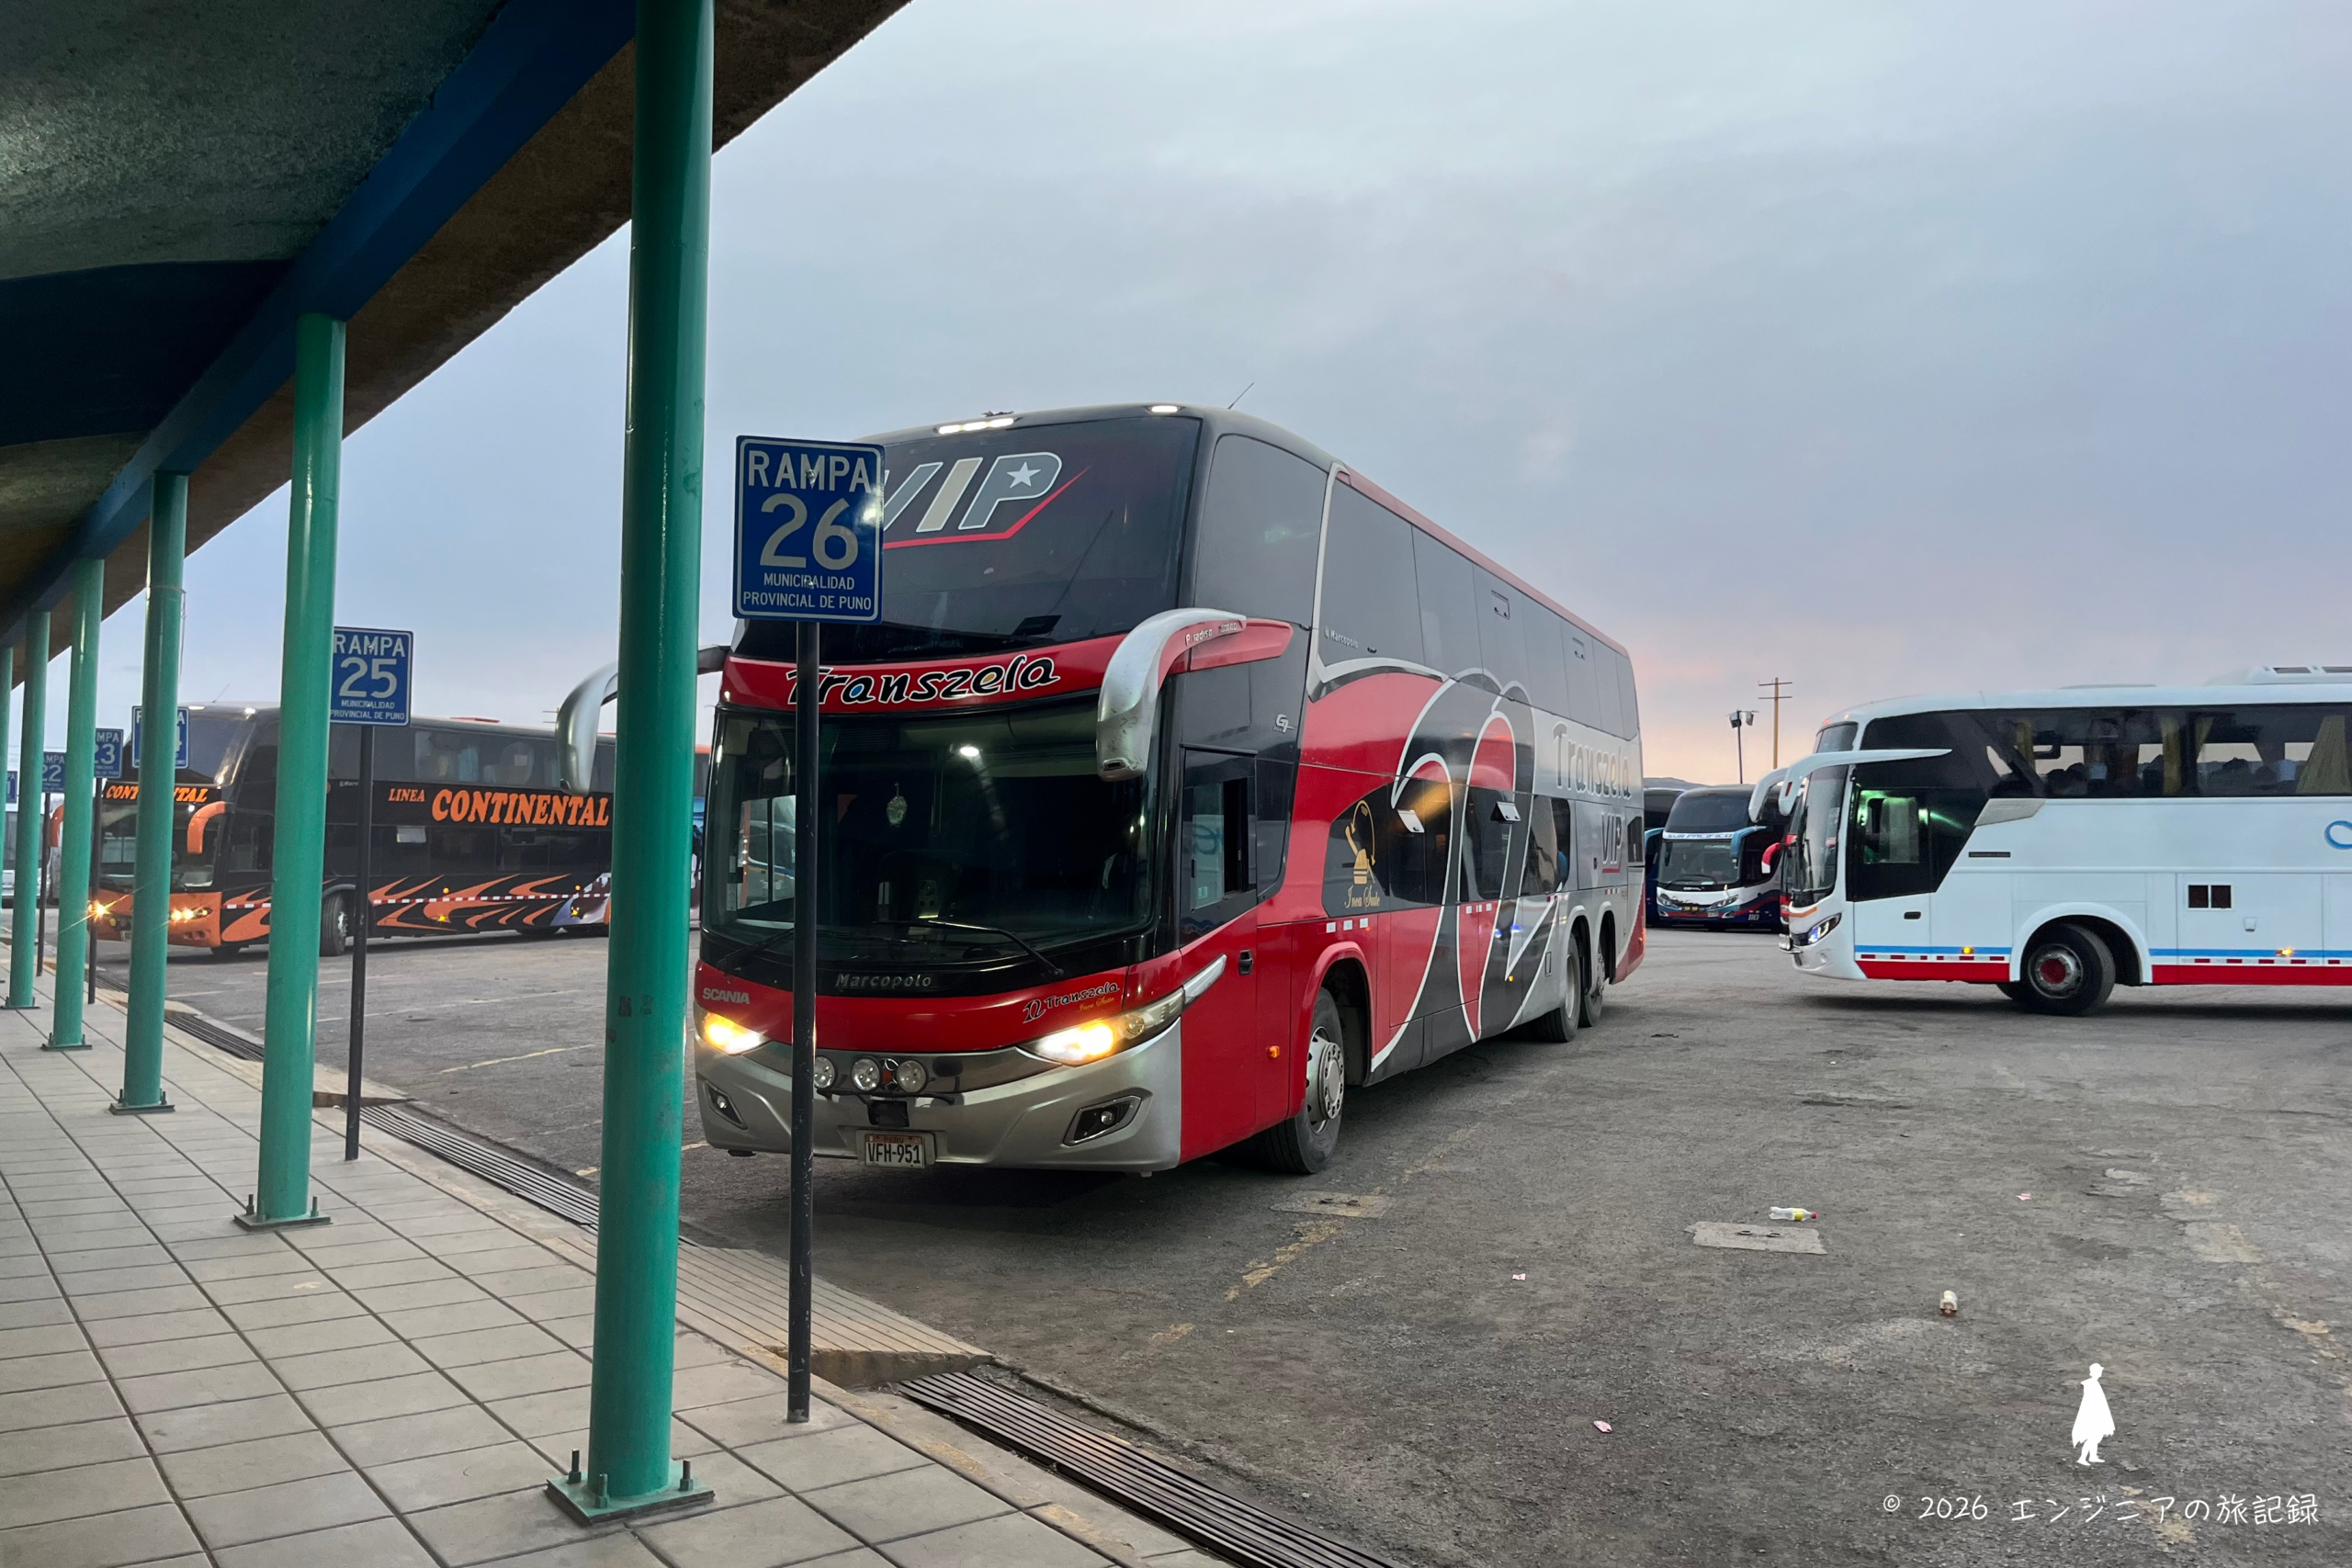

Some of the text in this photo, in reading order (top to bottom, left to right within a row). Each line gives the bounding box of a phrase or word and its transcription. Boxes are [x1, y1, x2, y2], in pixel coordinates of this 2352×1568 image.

[748, 450, 872, 494] RAMPA
[760, 492, 859, 570] 26
[763, 573, 854, 591] MUNICIPALIDAD
[743, 592, 872, 611] PROVINCIAL DE PUNO
[334, 634, 405, 658] RAMPA
[1330, 629, 1359, 649] Marcopolo
[339, 656, 398, 699] 25
[786, 654, 1061, 705] Transzela
[331, 709, 405, 720] PROVINCIAL DE PUNO
[341, 699, 395, 710] MUNICIPALIDAD
[96, 731, 119, 743] MPA
[1553, 721, 1631, 800] Transzela
[388, 788, 610, 826] LINEA CONTINENTAL
[1600, 812, 1624, 865] VIP
[835, 974, 932, 989] Marcopolo
[703, 987, 751, 1005] SCANIA
[1044, 981, 1120, 1009] Transzela
[867, 1142, 922, 1164] VFH-951
